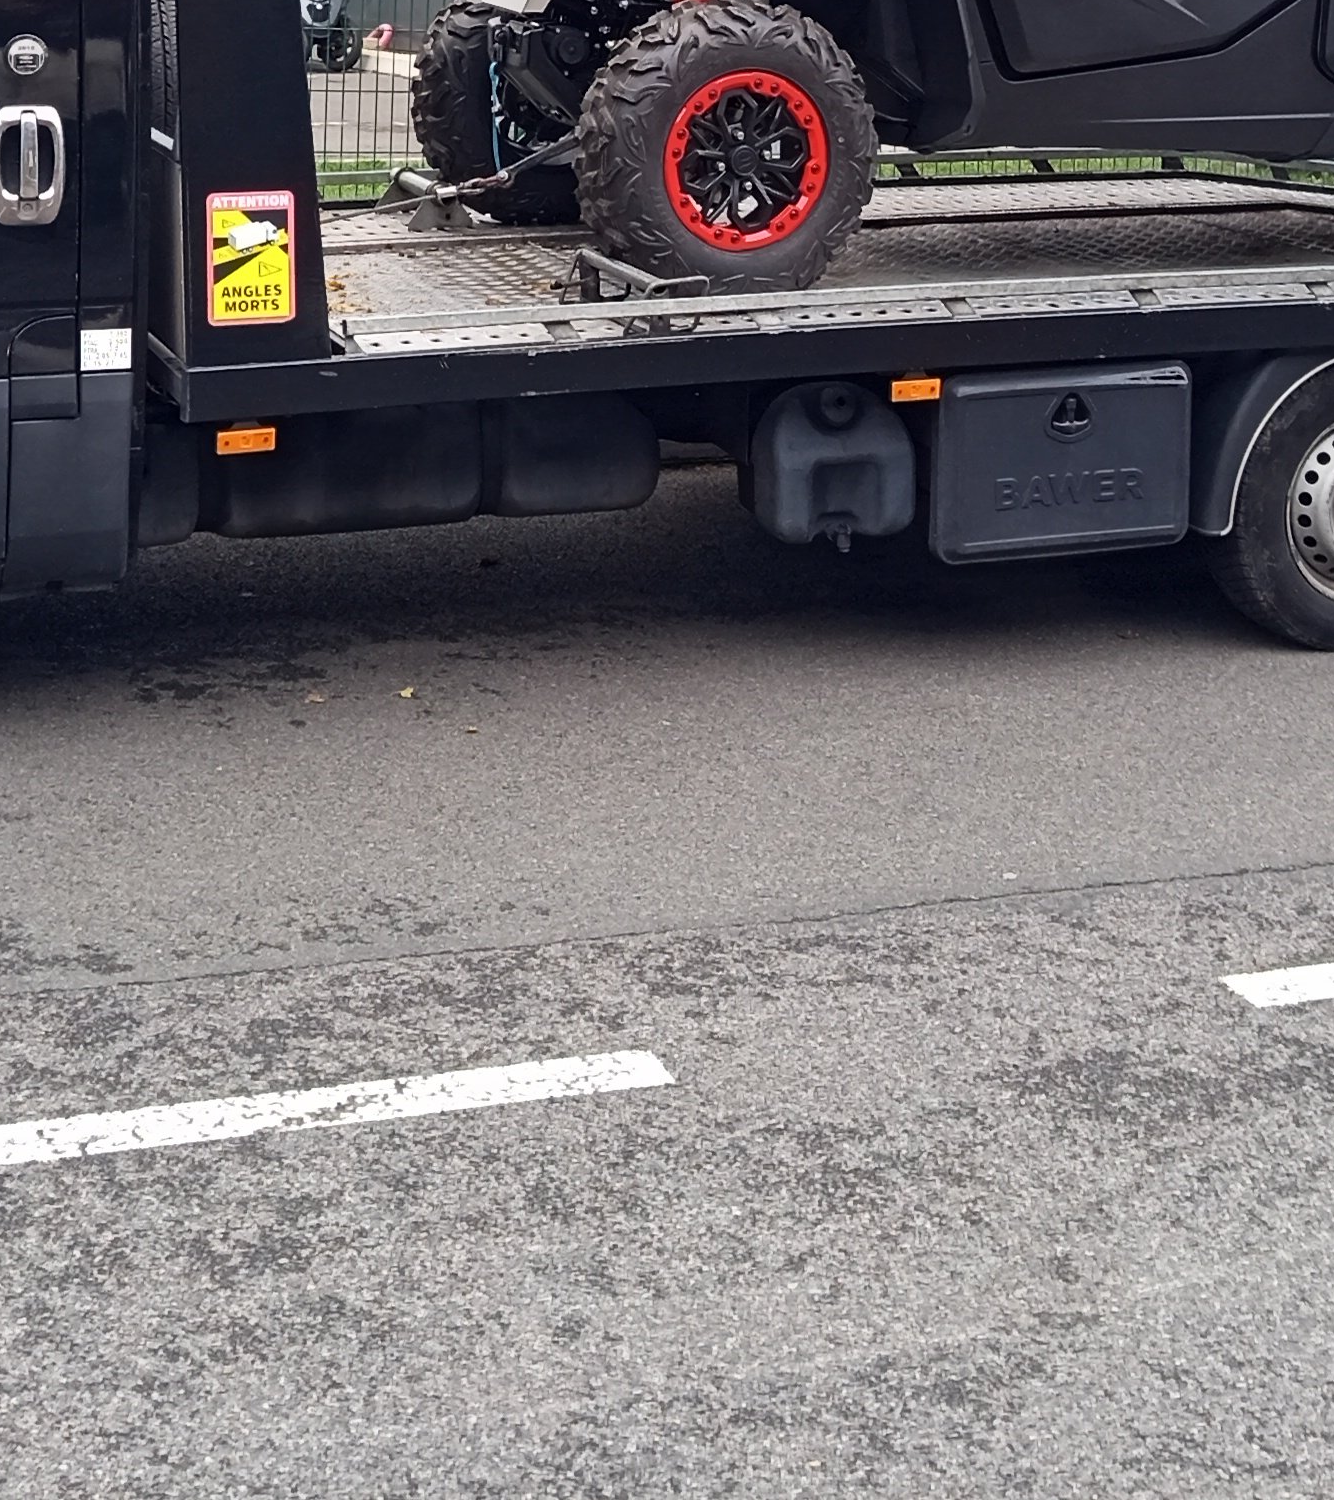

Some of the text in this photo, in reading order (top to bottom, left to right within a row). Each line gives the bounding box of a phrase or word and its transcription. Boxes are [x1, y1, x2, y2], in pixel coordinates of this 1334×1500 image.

[212, 195, 289, 208] ATTENTION
[222, 284, 282, 298] ANGLES
[224, 299, 280, 312] MORTS
[995, 468, 1144, 511] BAWER
